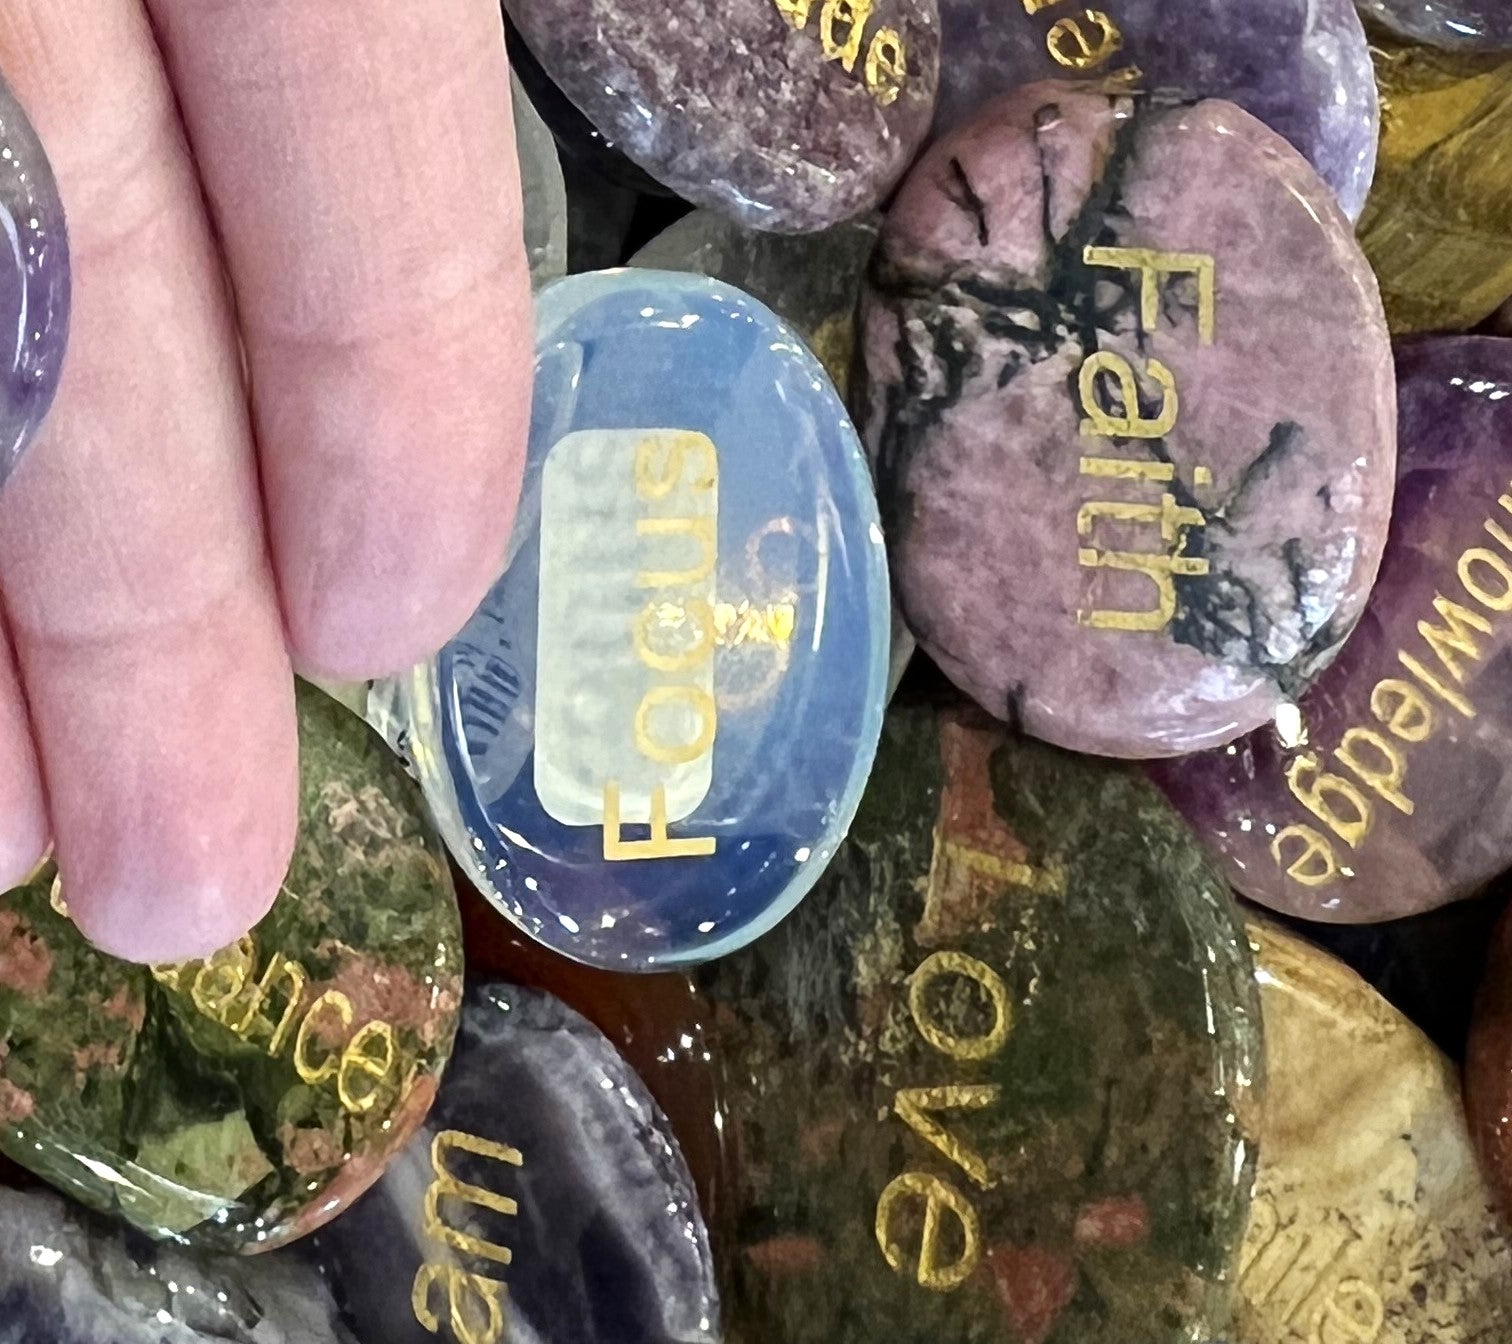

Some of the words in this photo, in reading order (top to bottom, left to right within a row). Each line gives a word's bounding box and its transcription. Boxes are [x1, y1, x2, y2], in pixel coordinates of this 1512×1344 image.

[1077, 244, 1218, 633] Faith
[1270, 492, 1512, 886] owledge
[874, 828, 1070, 1292] Love
